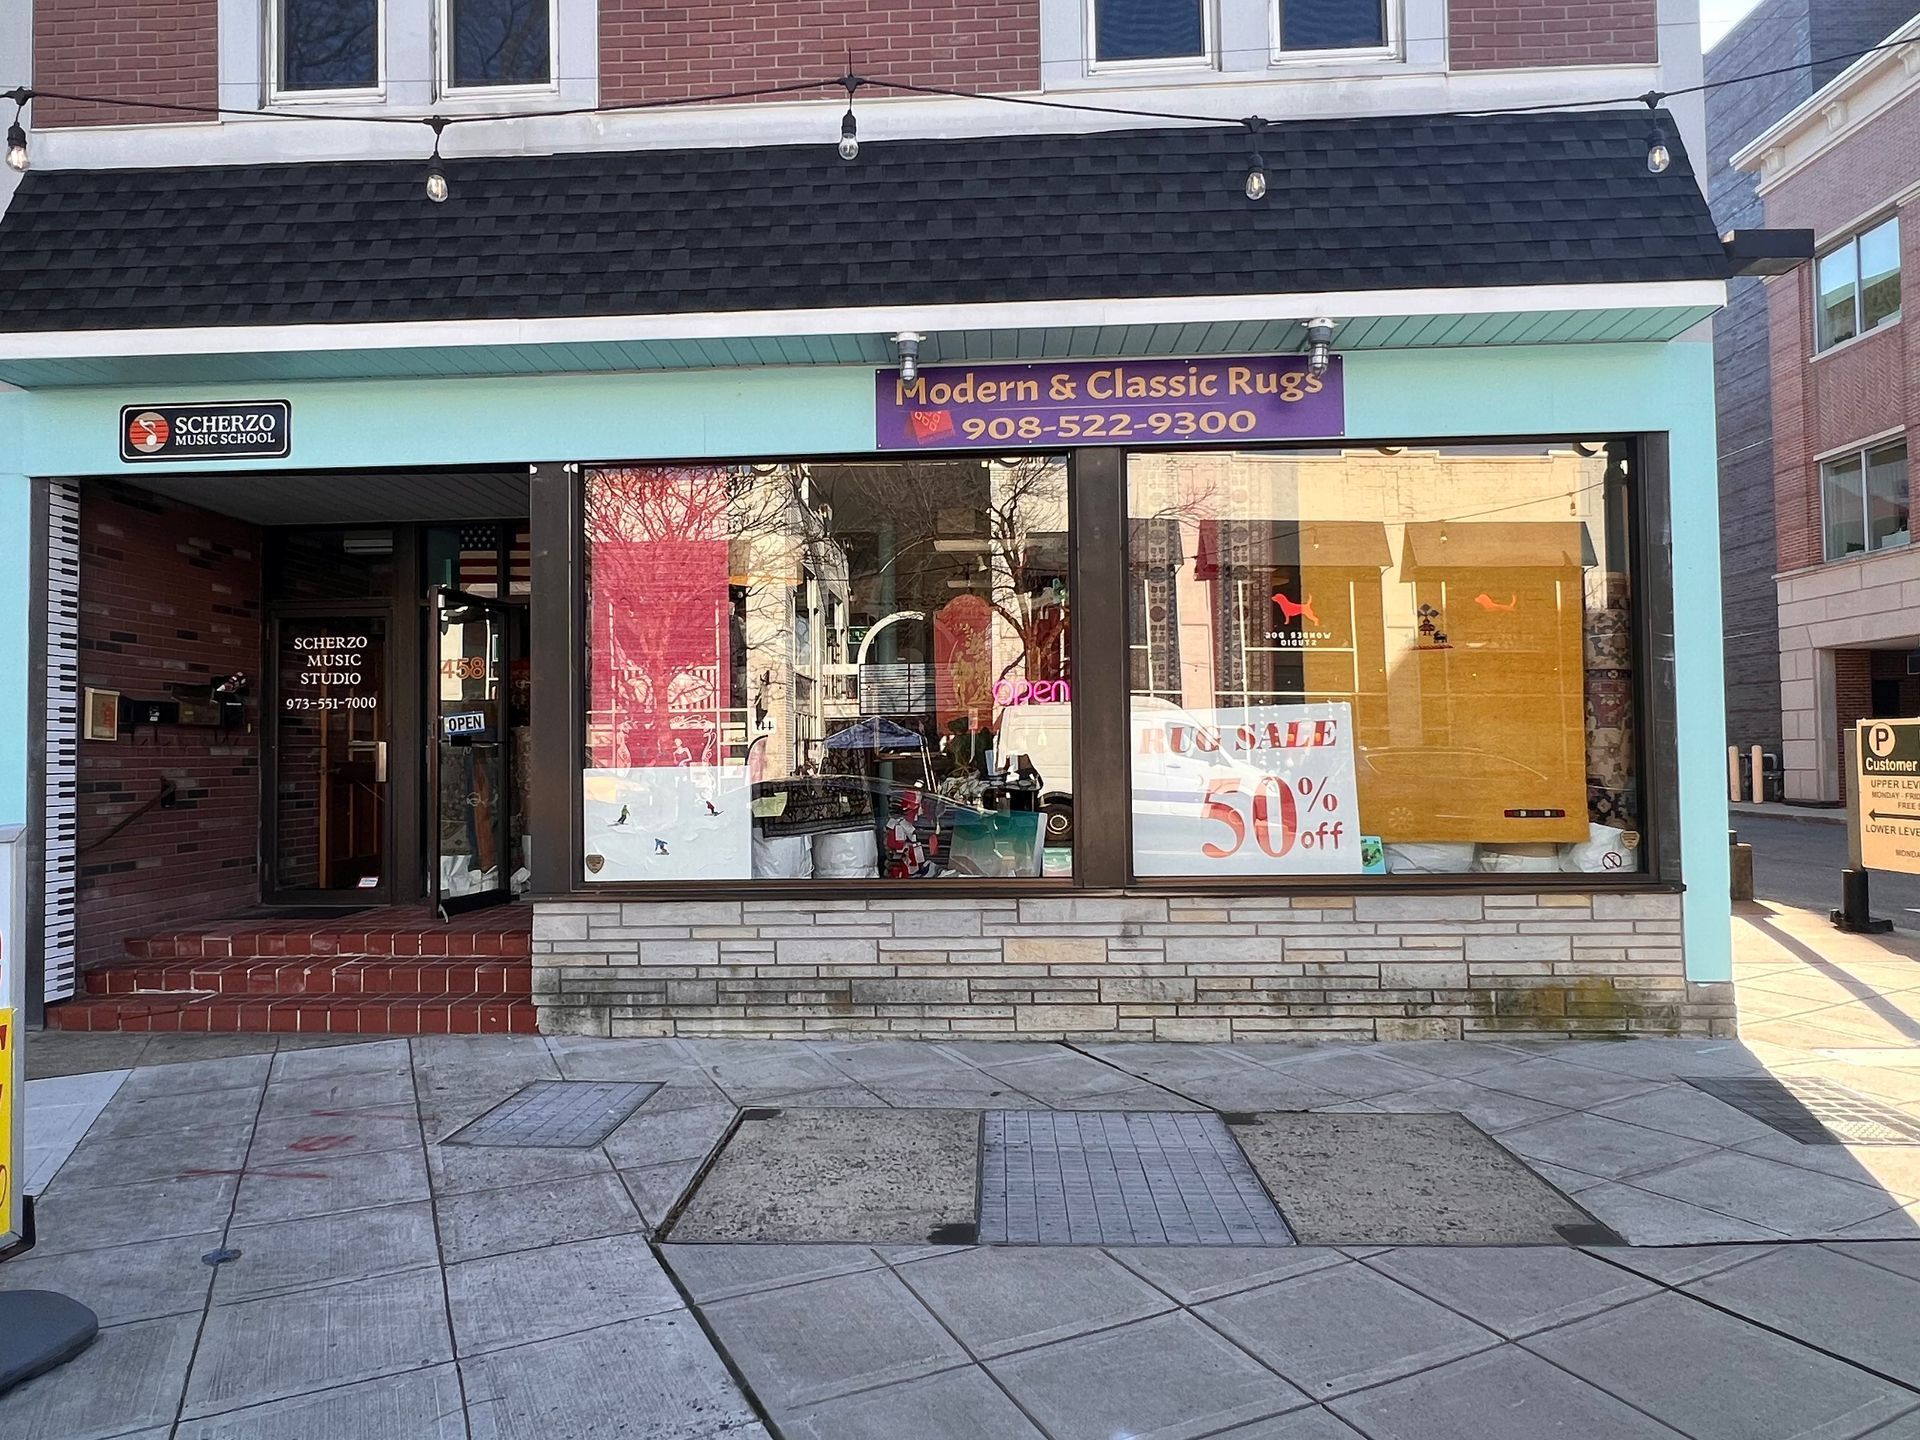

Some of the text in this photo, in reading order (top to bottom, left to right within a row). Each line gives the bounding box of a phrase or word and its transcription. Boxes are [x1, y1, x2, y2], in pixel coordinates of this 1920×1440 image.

[895, 366, 1324, 406] Modern & Classic Rugs
[175, 414, 276, 434] SCHERZO
[961, 410, 1257, 441] 908-522-9300
[175, 432, 276, 446] MUSIC SCHOOL
[294, 636, 368, 650] SCHERZO
[307, 654, 362, 667] MUSIC
[441, 656, 486, 679] 458
[300, 672, 362, 685] STUDIO
[286, 697, 377, 710] 973-551-7000
[448, 715, 482, 731] OPEN
[1139, 720, 1338, 754] RUG SALE
[1875, 728, 1889, 751] P
[1865, 757, 1918, 772] Customer
[1871, 779, 1899, 789] UPPER
[1872, 791, 1899, 799] MONDAY
[1897, 801, 1915, 810] FREE
[1301, 821, 1343, 850] off
[1865, 824, 1897, 835] LOWER
